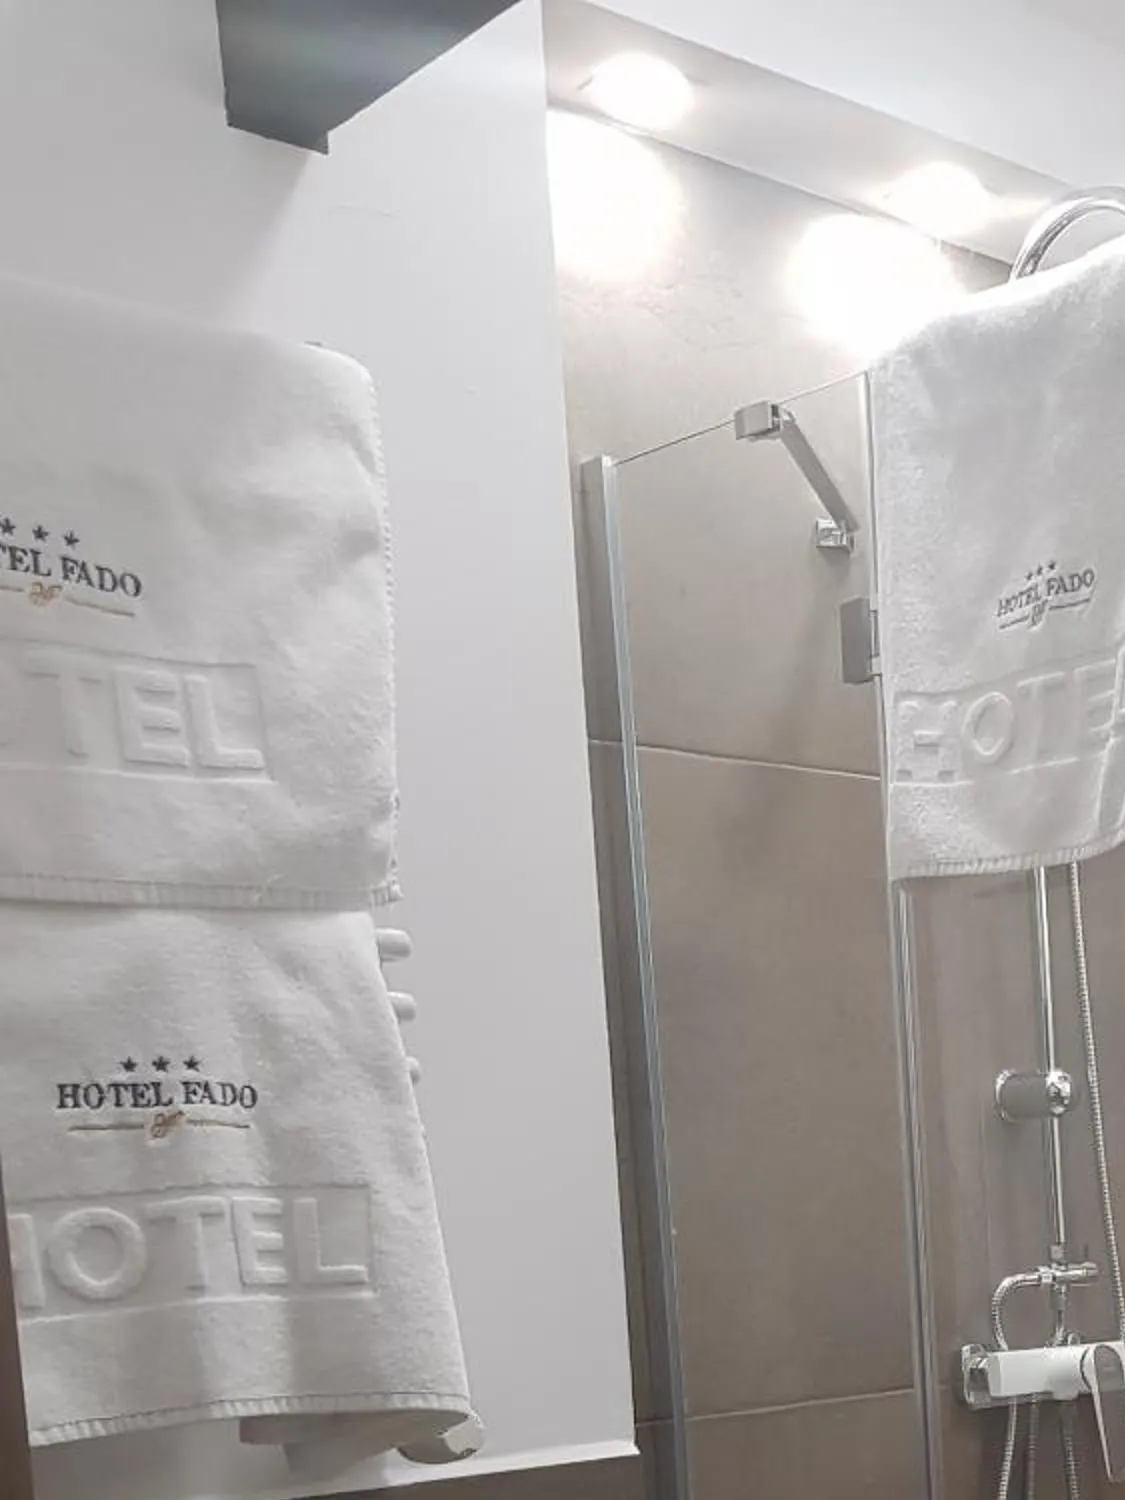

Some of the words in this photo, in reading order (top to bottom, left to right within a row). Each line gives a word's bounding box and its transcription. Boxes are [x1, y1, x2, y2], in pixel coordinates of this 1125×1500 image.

[0, 543, 52, 577] EL
[60, 555, 142, 598] FADO
[996, 582, 1042, 617] HOTEL
[1047, 568, 1095, 597] FADO
[0, 648, 267, 770] TEL
[56, 1081, 173, 1110] HOTEL
[182, 1081, 259, 1109] FADO
